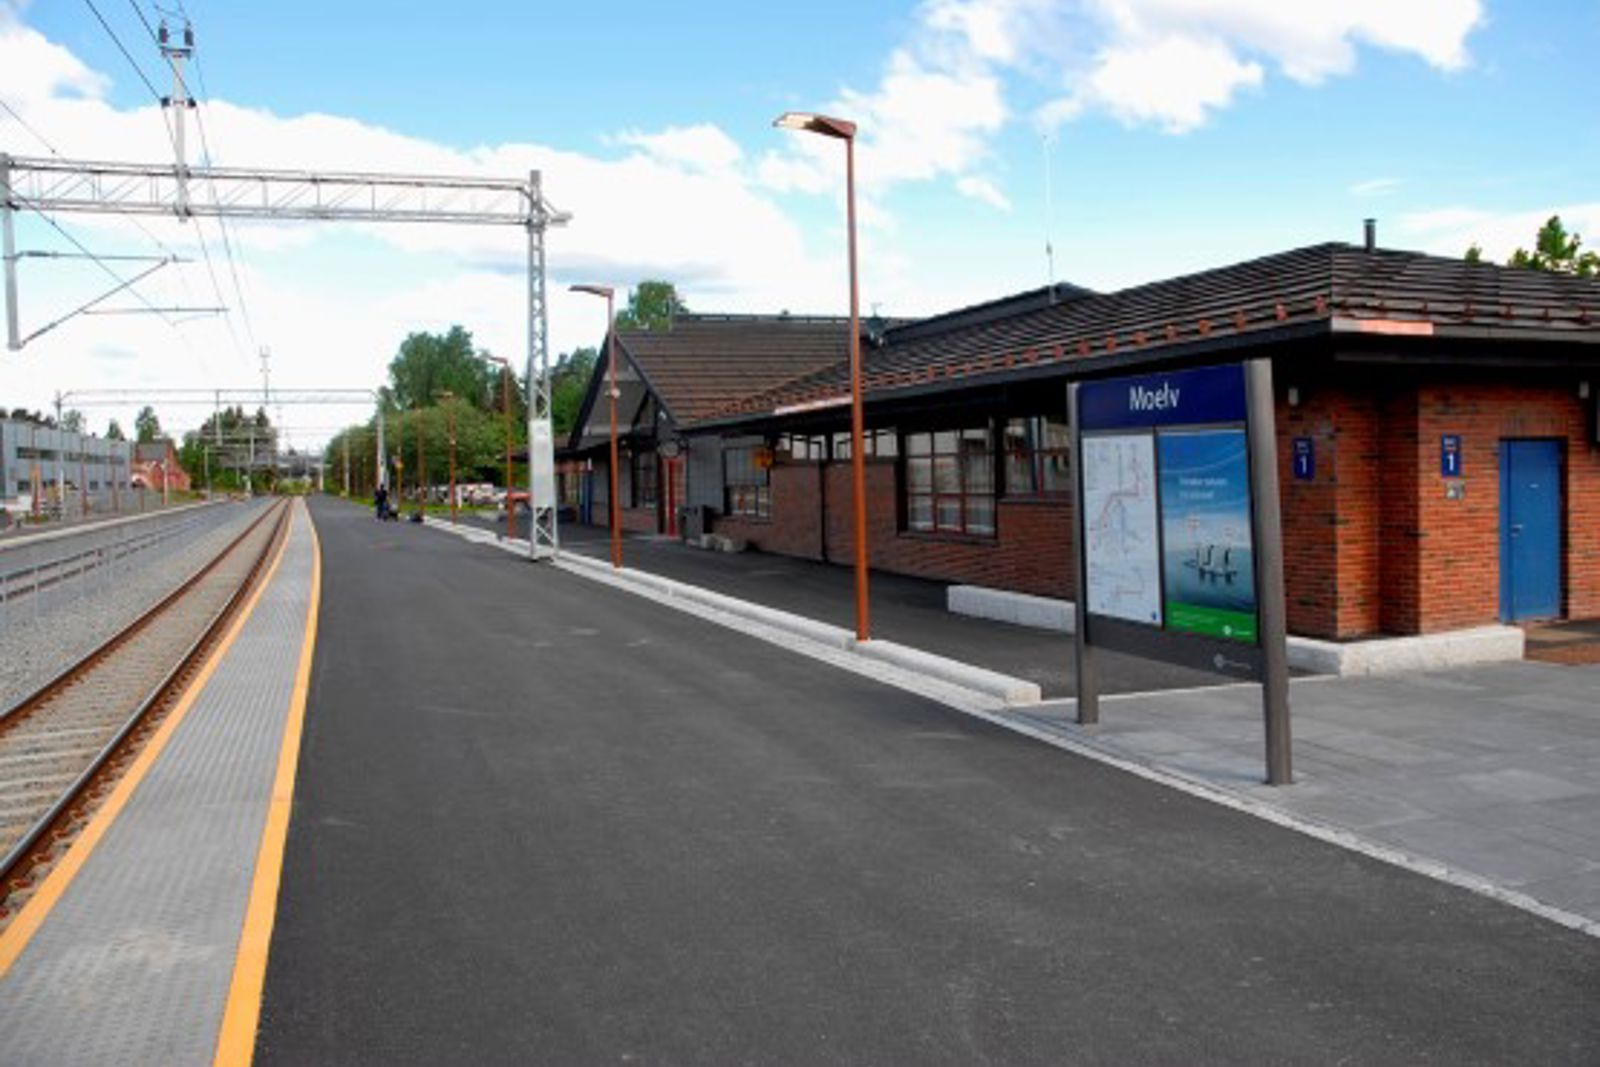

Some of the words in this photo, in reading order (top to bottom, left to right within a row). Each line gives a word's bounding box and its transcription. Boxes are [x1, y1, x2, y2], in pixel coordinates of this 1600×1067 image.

[1129, 381, 1180, 411] Moelv
[1299, 455, 1308, 474] 1
[1446, 453, 1455, 472] 1
